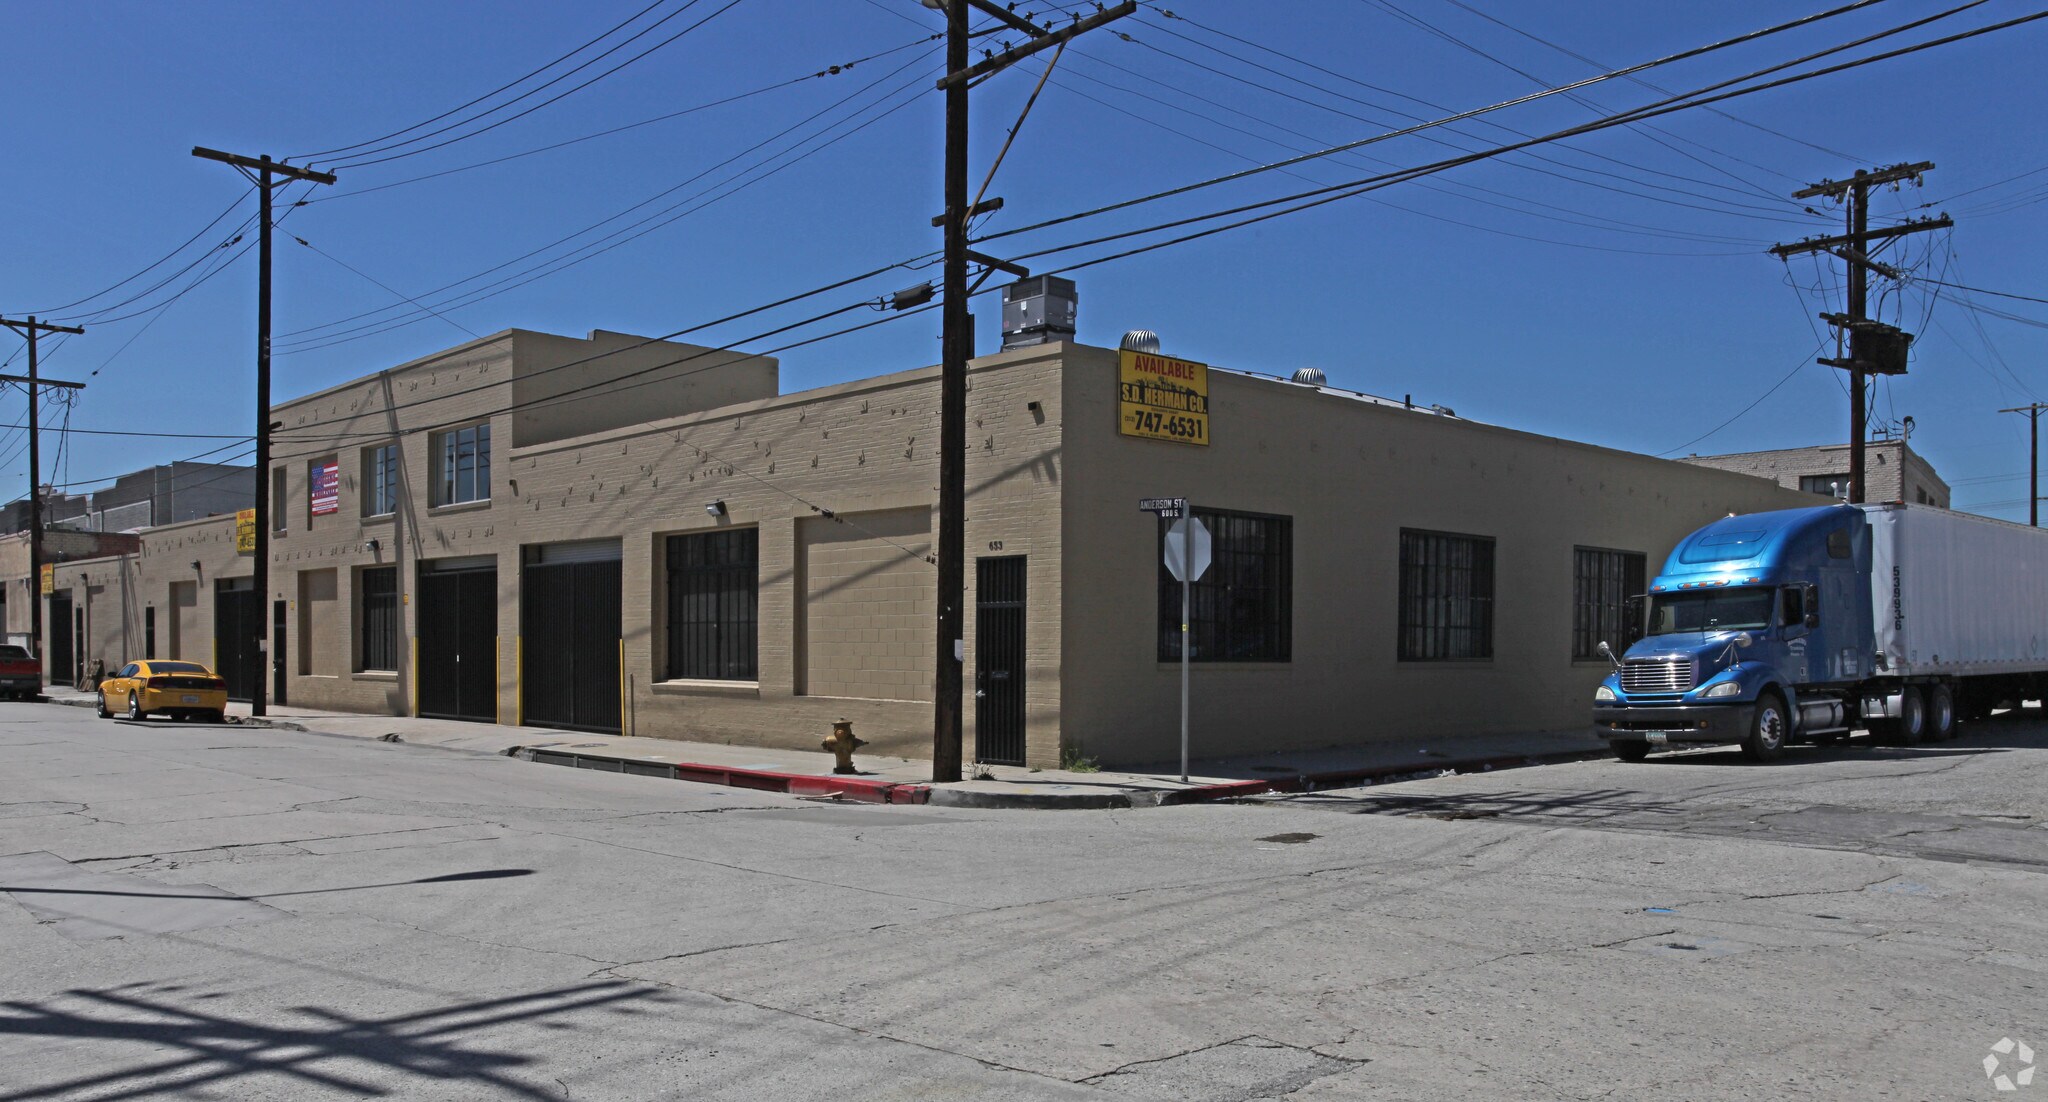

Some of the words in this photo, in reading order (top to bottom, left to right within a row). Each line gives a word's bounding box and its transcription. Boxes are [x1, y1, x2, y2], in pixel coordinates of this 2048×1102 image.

[1134, 355, 1194, 380] AVAILABLE
[1122, 384, 1142, 404] S.D.
[1144, 388, 1187, 410] HERMAN
[1189, 395, 1207, 413] CO.
[1135, 410, 1203, 439] 747-6531
[1140, 500, 1172, 510] ANDERSON
[1161, 509, 1173, 517] 600
[1893, 565, 1902, 631] 539936
